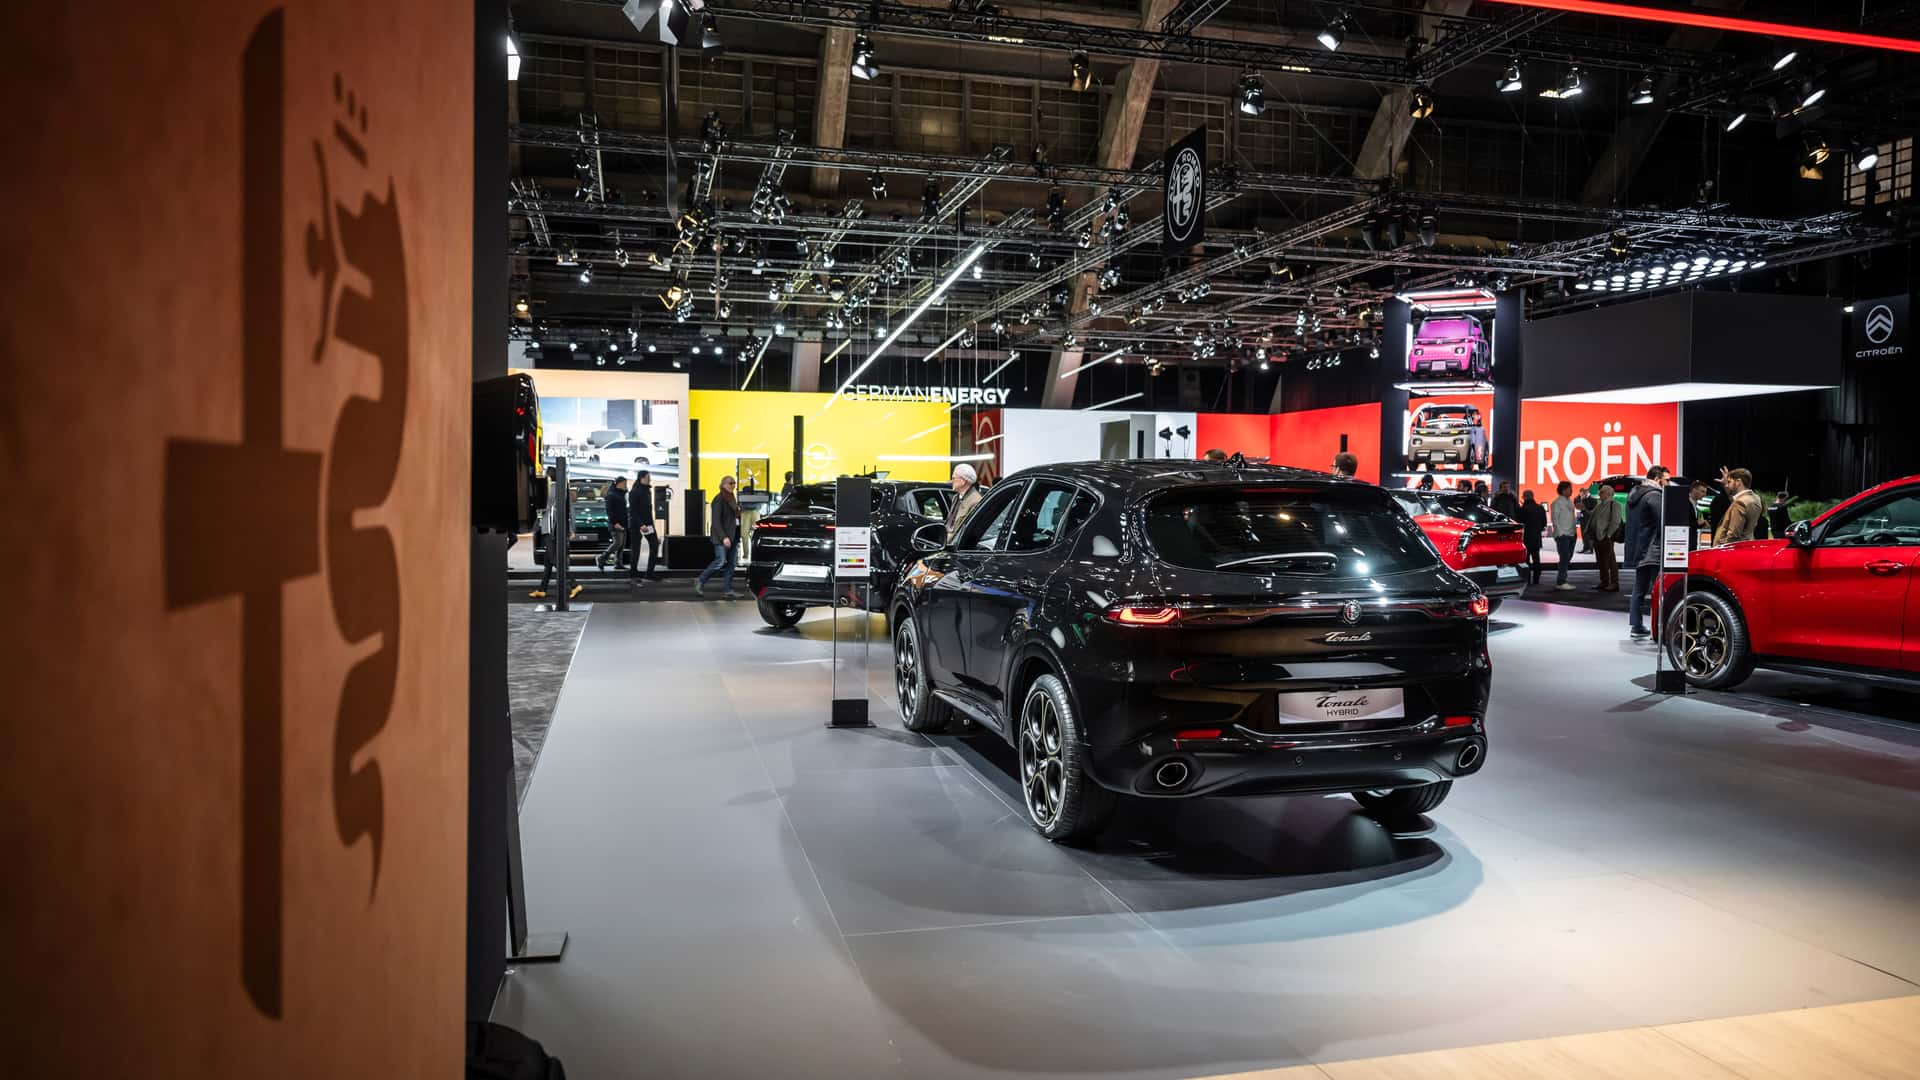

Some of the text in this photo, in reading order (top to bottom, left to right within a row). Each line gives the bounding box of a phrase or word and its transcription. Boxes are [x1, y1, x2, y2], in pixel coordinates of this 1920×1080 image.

[1519, 421, 1662, 485] TROËN
[1315, 695, 1370, 708] Tonale
[1326, 708, 1360, 717] HYBRID
